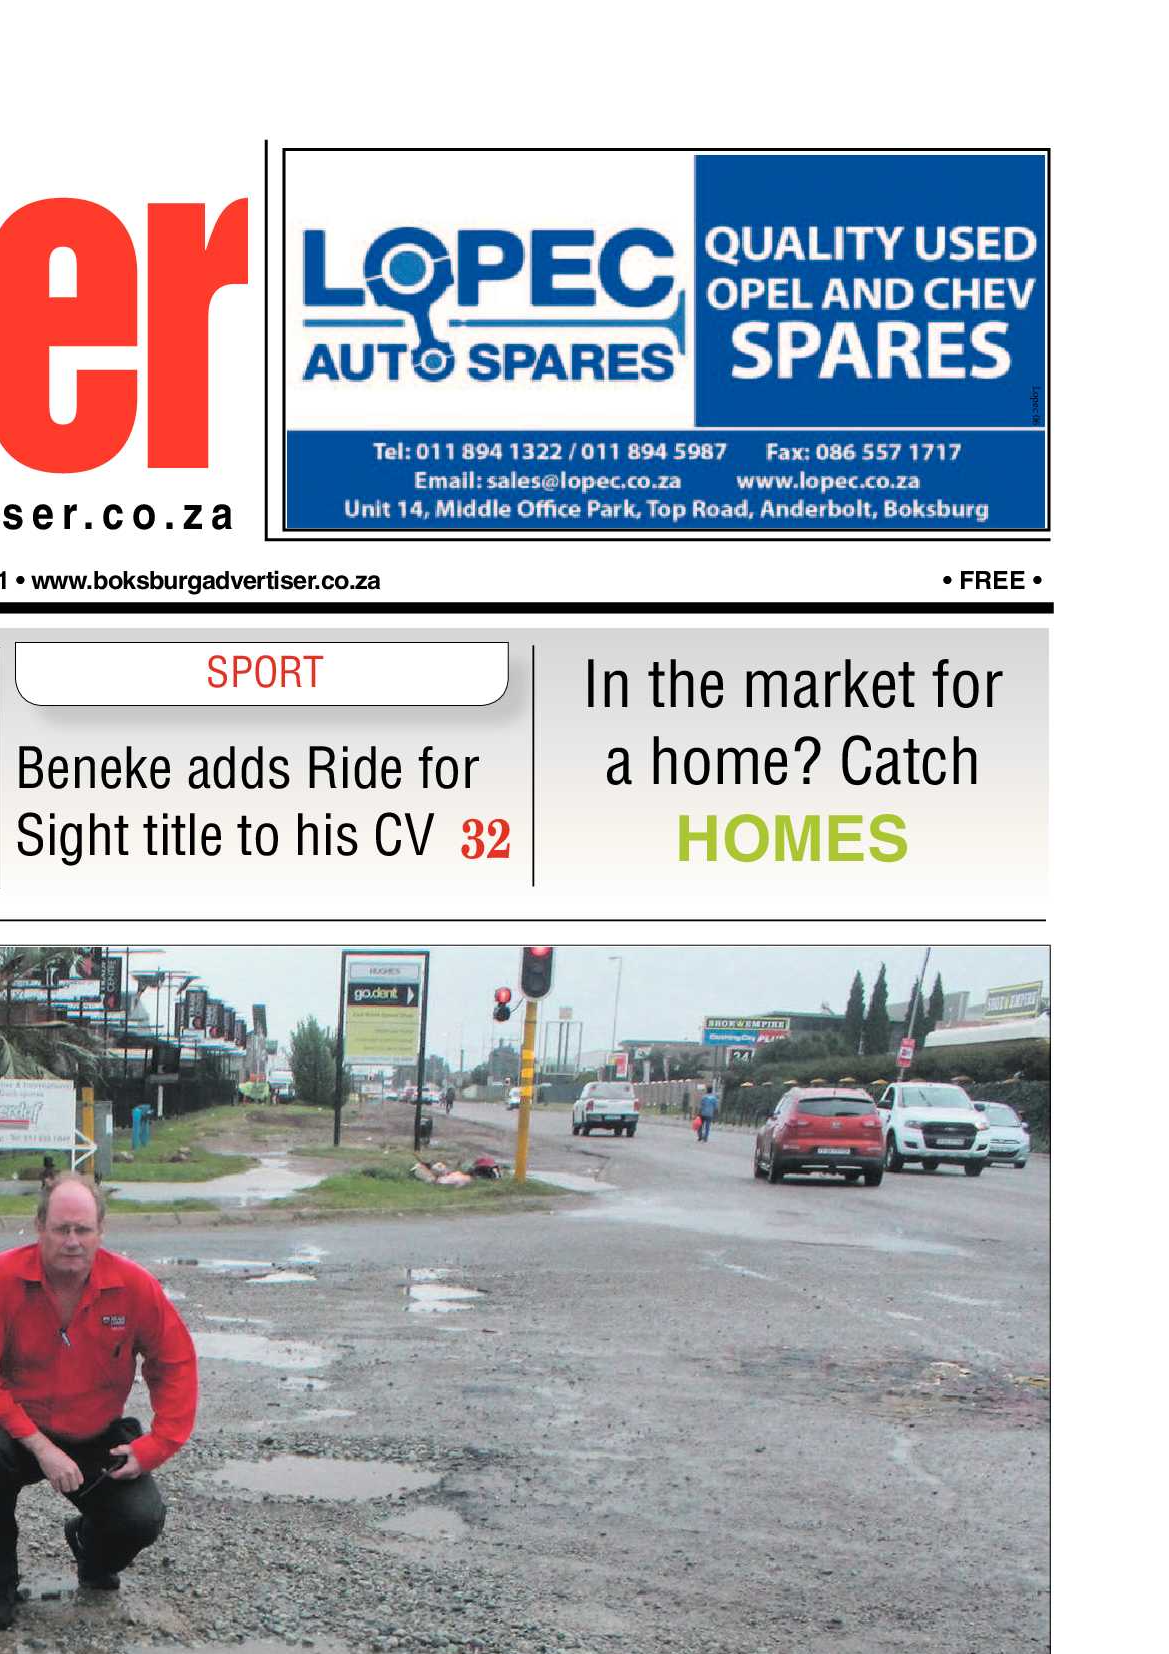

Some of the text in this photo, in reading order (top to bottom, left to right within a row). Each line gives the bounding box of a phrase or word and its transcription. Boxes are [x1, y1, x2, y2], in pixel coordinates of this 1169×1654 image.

[705, 226, 1036, 266] QUALITY USED
[302, 226, 676, 308] LOPEC
[708, 278, 1034, 310] OPEL AND CHEV
[303, 340, 676, 384] AUTO SPARES
[732, 322, 1010, 379] SPARES
[374, 443, 726, 459] Tel: 011 894 1322 011 894 5987
[768, 443, 961, 460] Fax: 086 557 1717
[415, 471, 920, 492] Email: sales@lopec.co.za www.lopec.co.za
[31, 571, 380, 595] www.boksburgadvertiser.co.za
[961, 571, 1025, 589] FREE
[208, 655, 324, 688] SPORT
[462, 819, 510, 859] 32
[679, 814, 907, 862] HOMES
